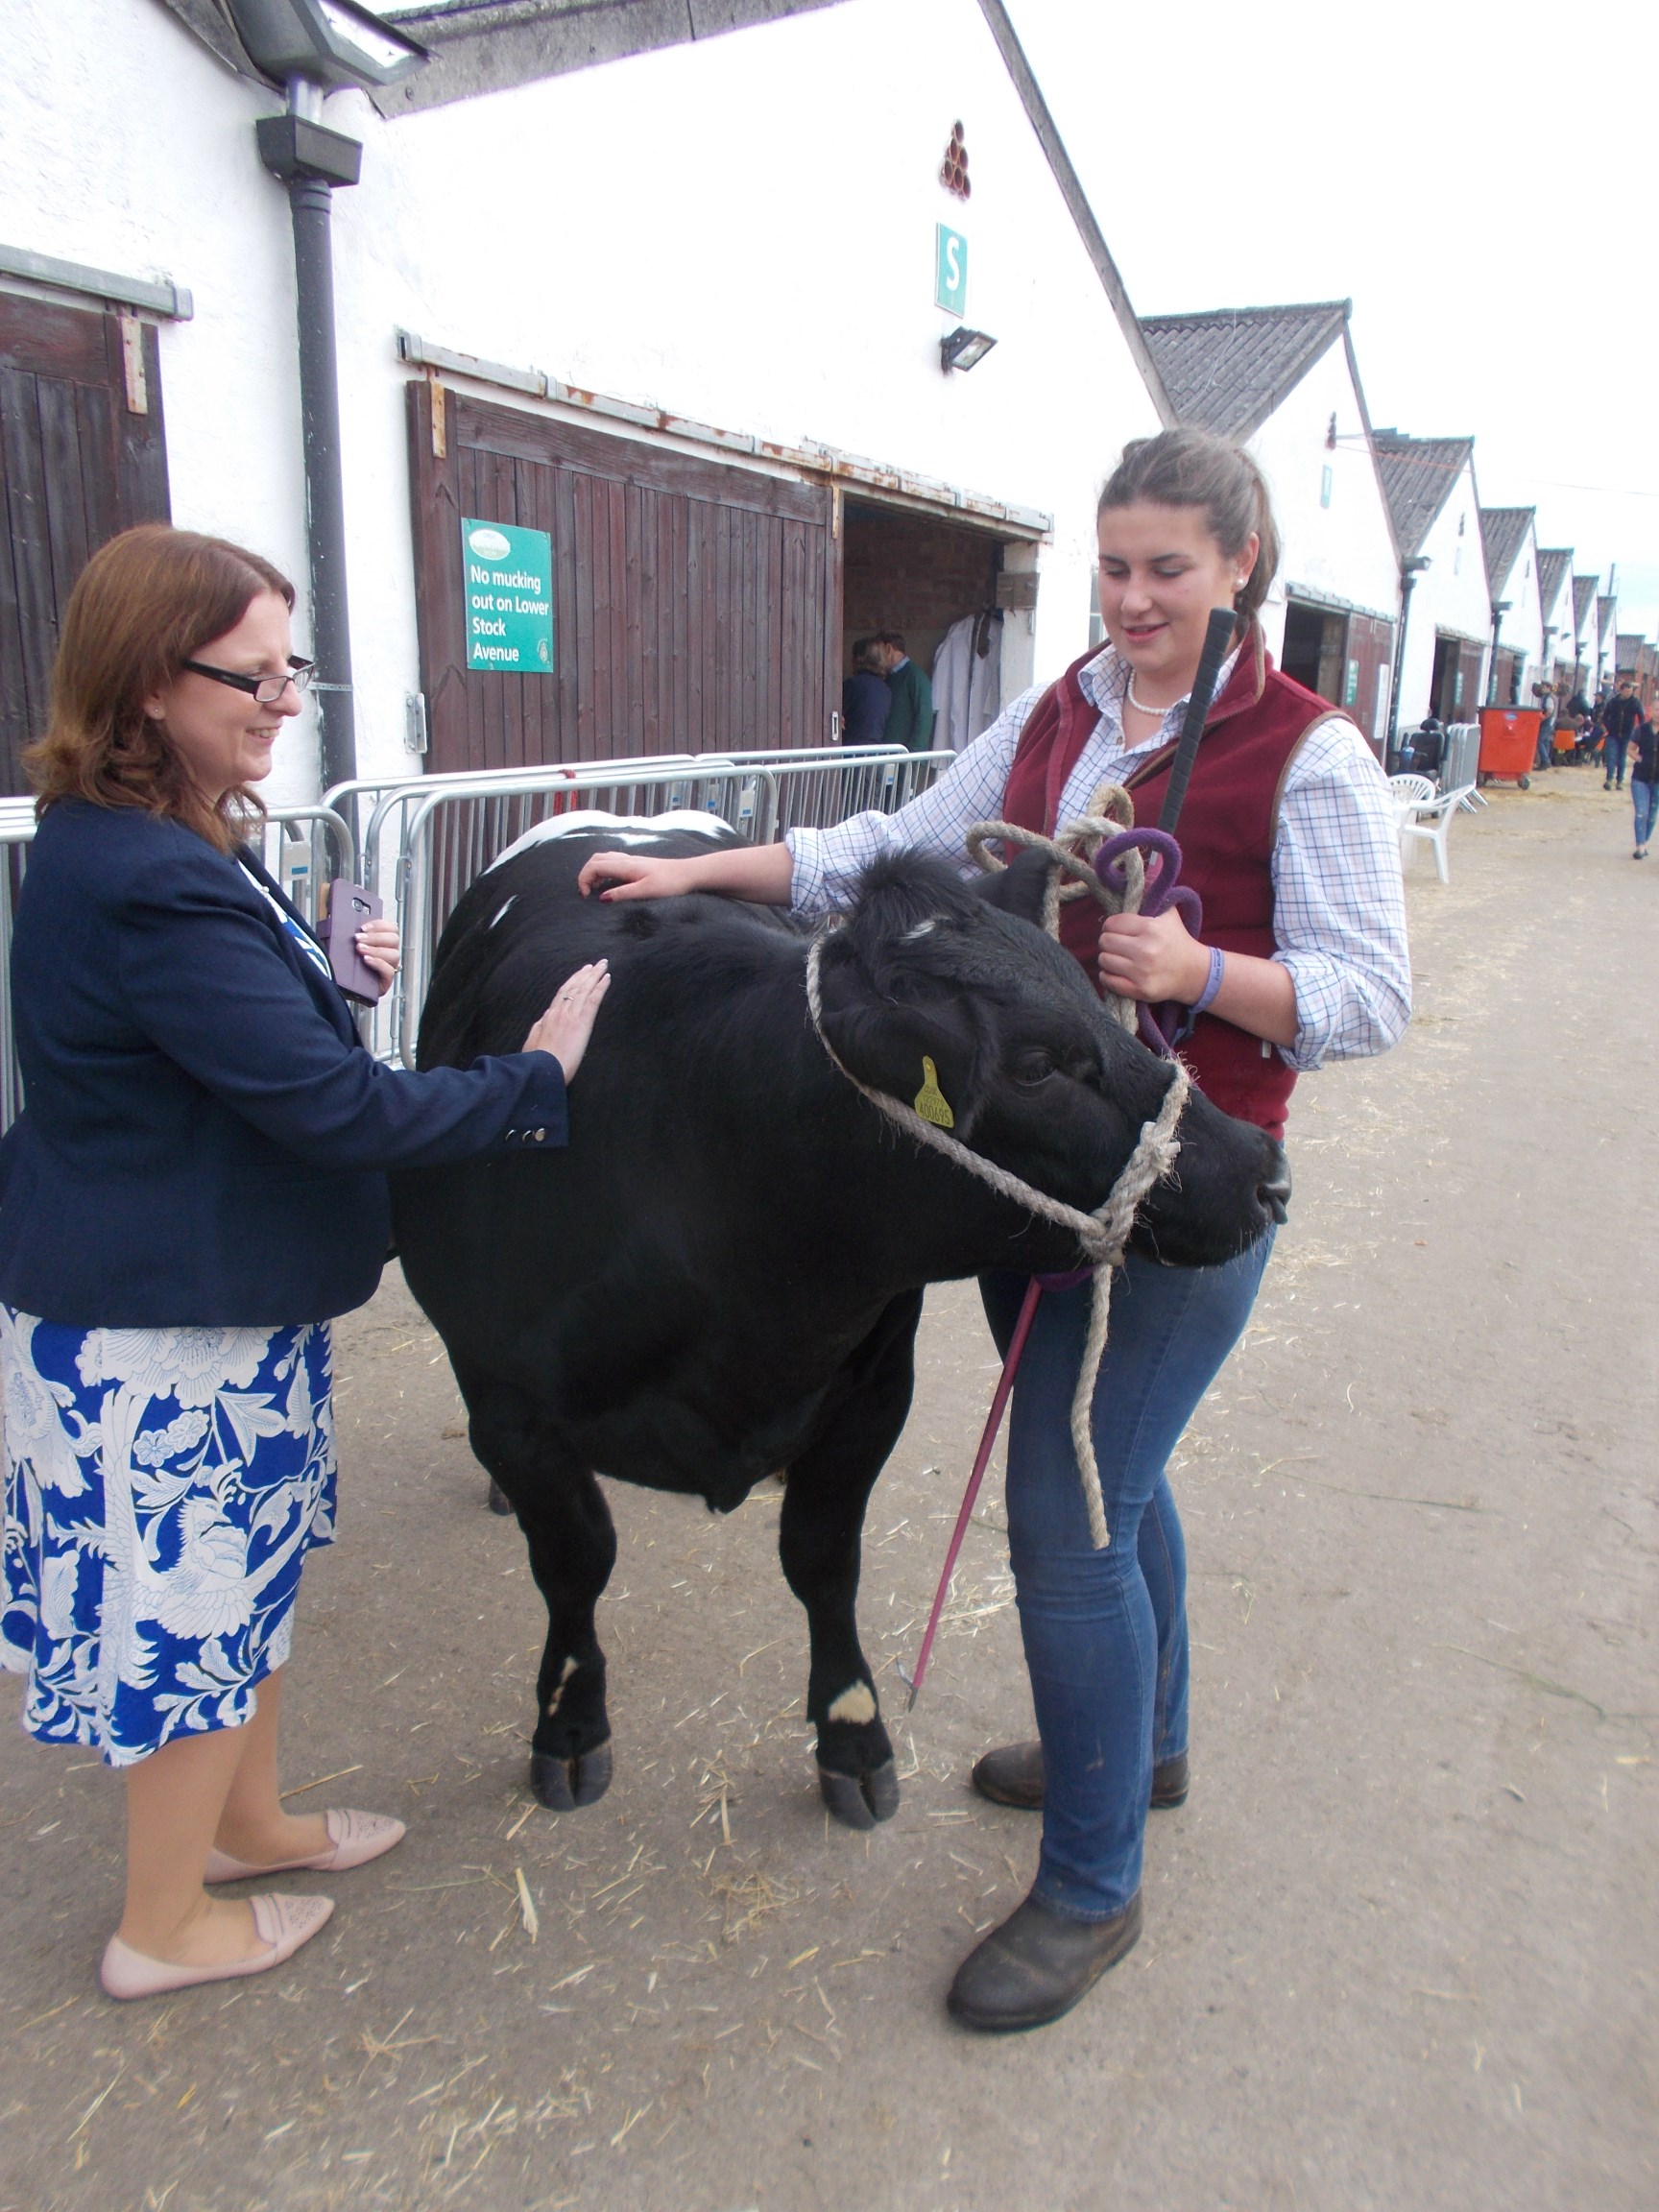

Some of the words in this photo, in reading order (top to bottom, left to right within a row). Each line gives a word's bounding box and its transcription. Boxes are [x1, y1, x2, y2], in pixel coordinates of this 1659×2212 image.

[947, 236, 960, 291] S
[470, 565, 490, 585] No
[493, 569, 541, 595] mucking
[471, 594, 494, 611] out
[496, 597, 512, 612] on
[516, 595, 549, 615] Lower
[472, 616, 506, 637] Stock
[473, 642, 519, 662] Avenue
